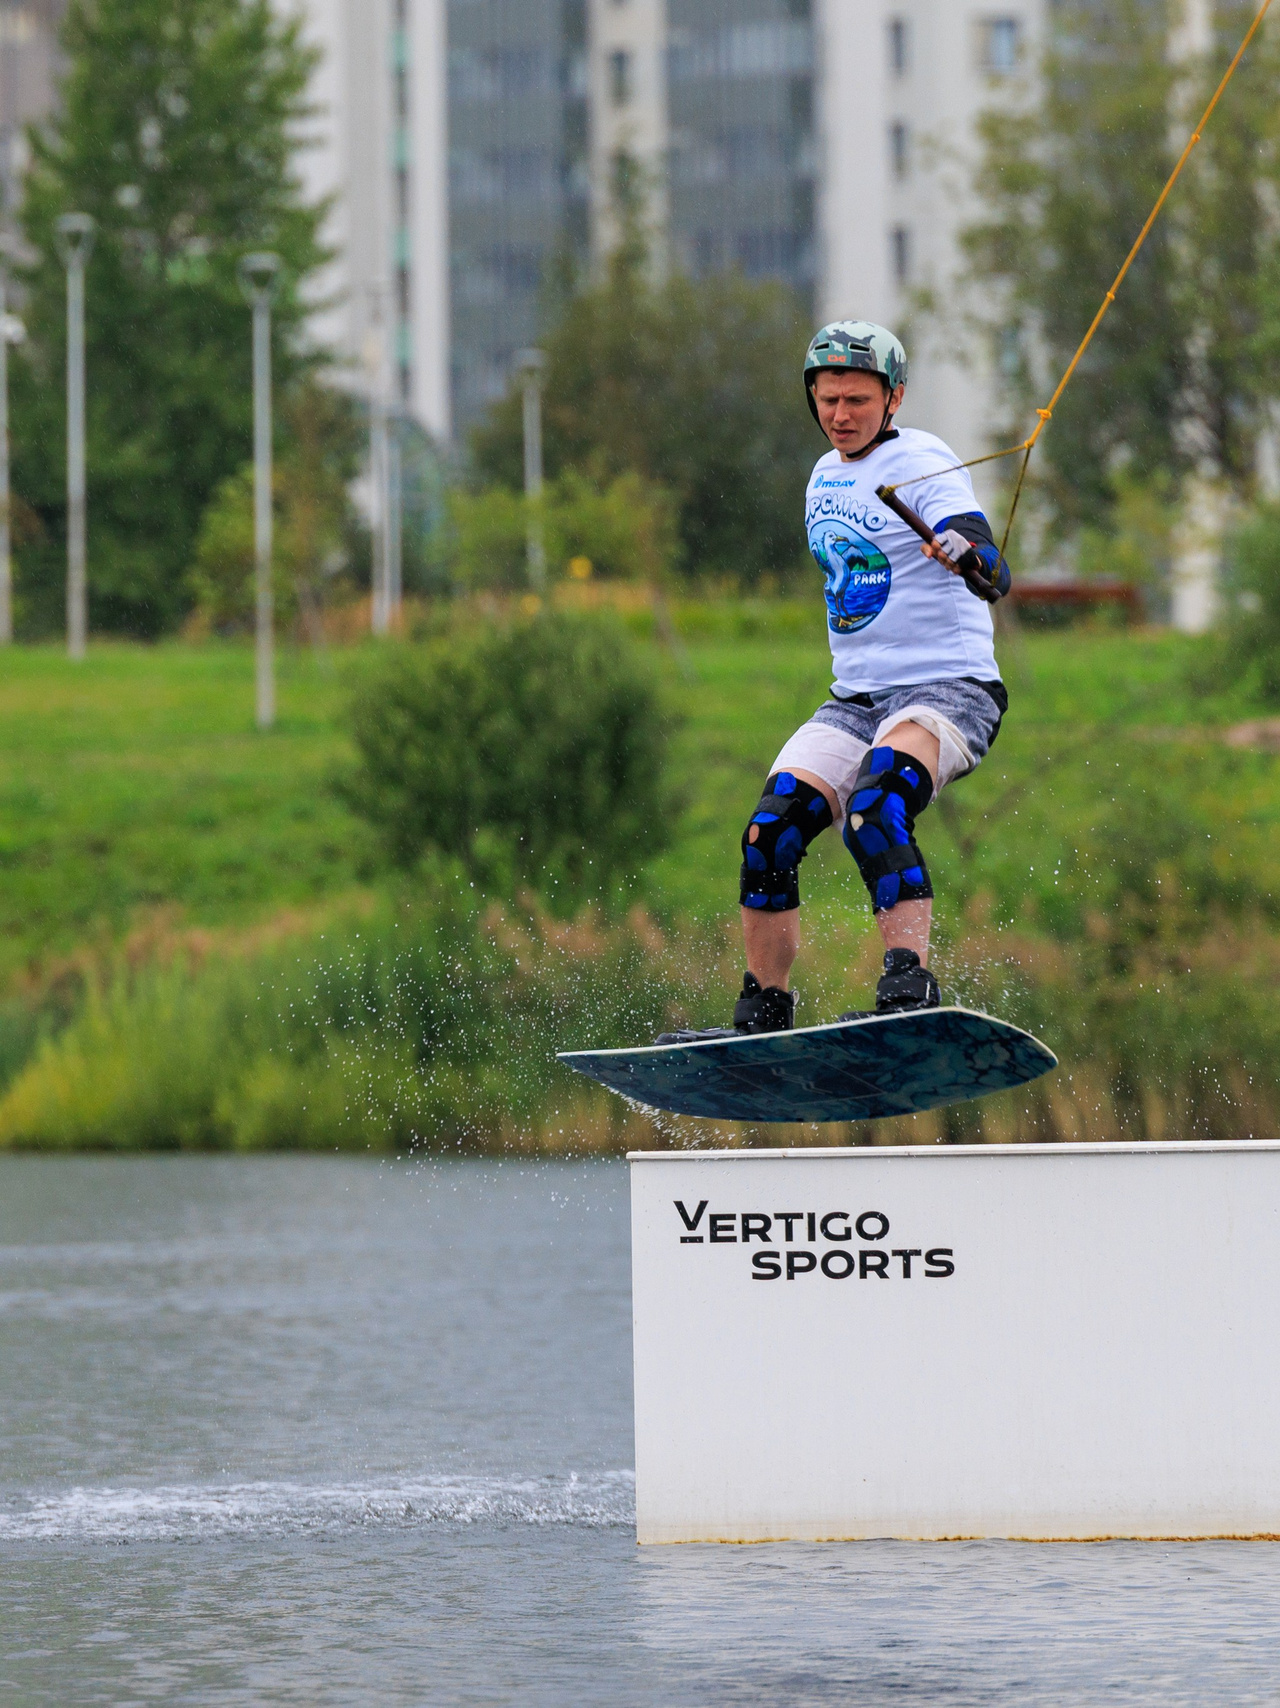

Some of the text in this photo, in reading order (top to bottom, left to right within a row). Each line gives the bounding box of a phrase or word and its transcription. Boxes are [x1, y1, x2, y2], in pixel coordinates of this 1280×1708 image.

[854, 571, 887, 586] PARK
[673, 1200, 890, 1243] VERTIGO
[751, 1248, 955, 1280] SPORTS
